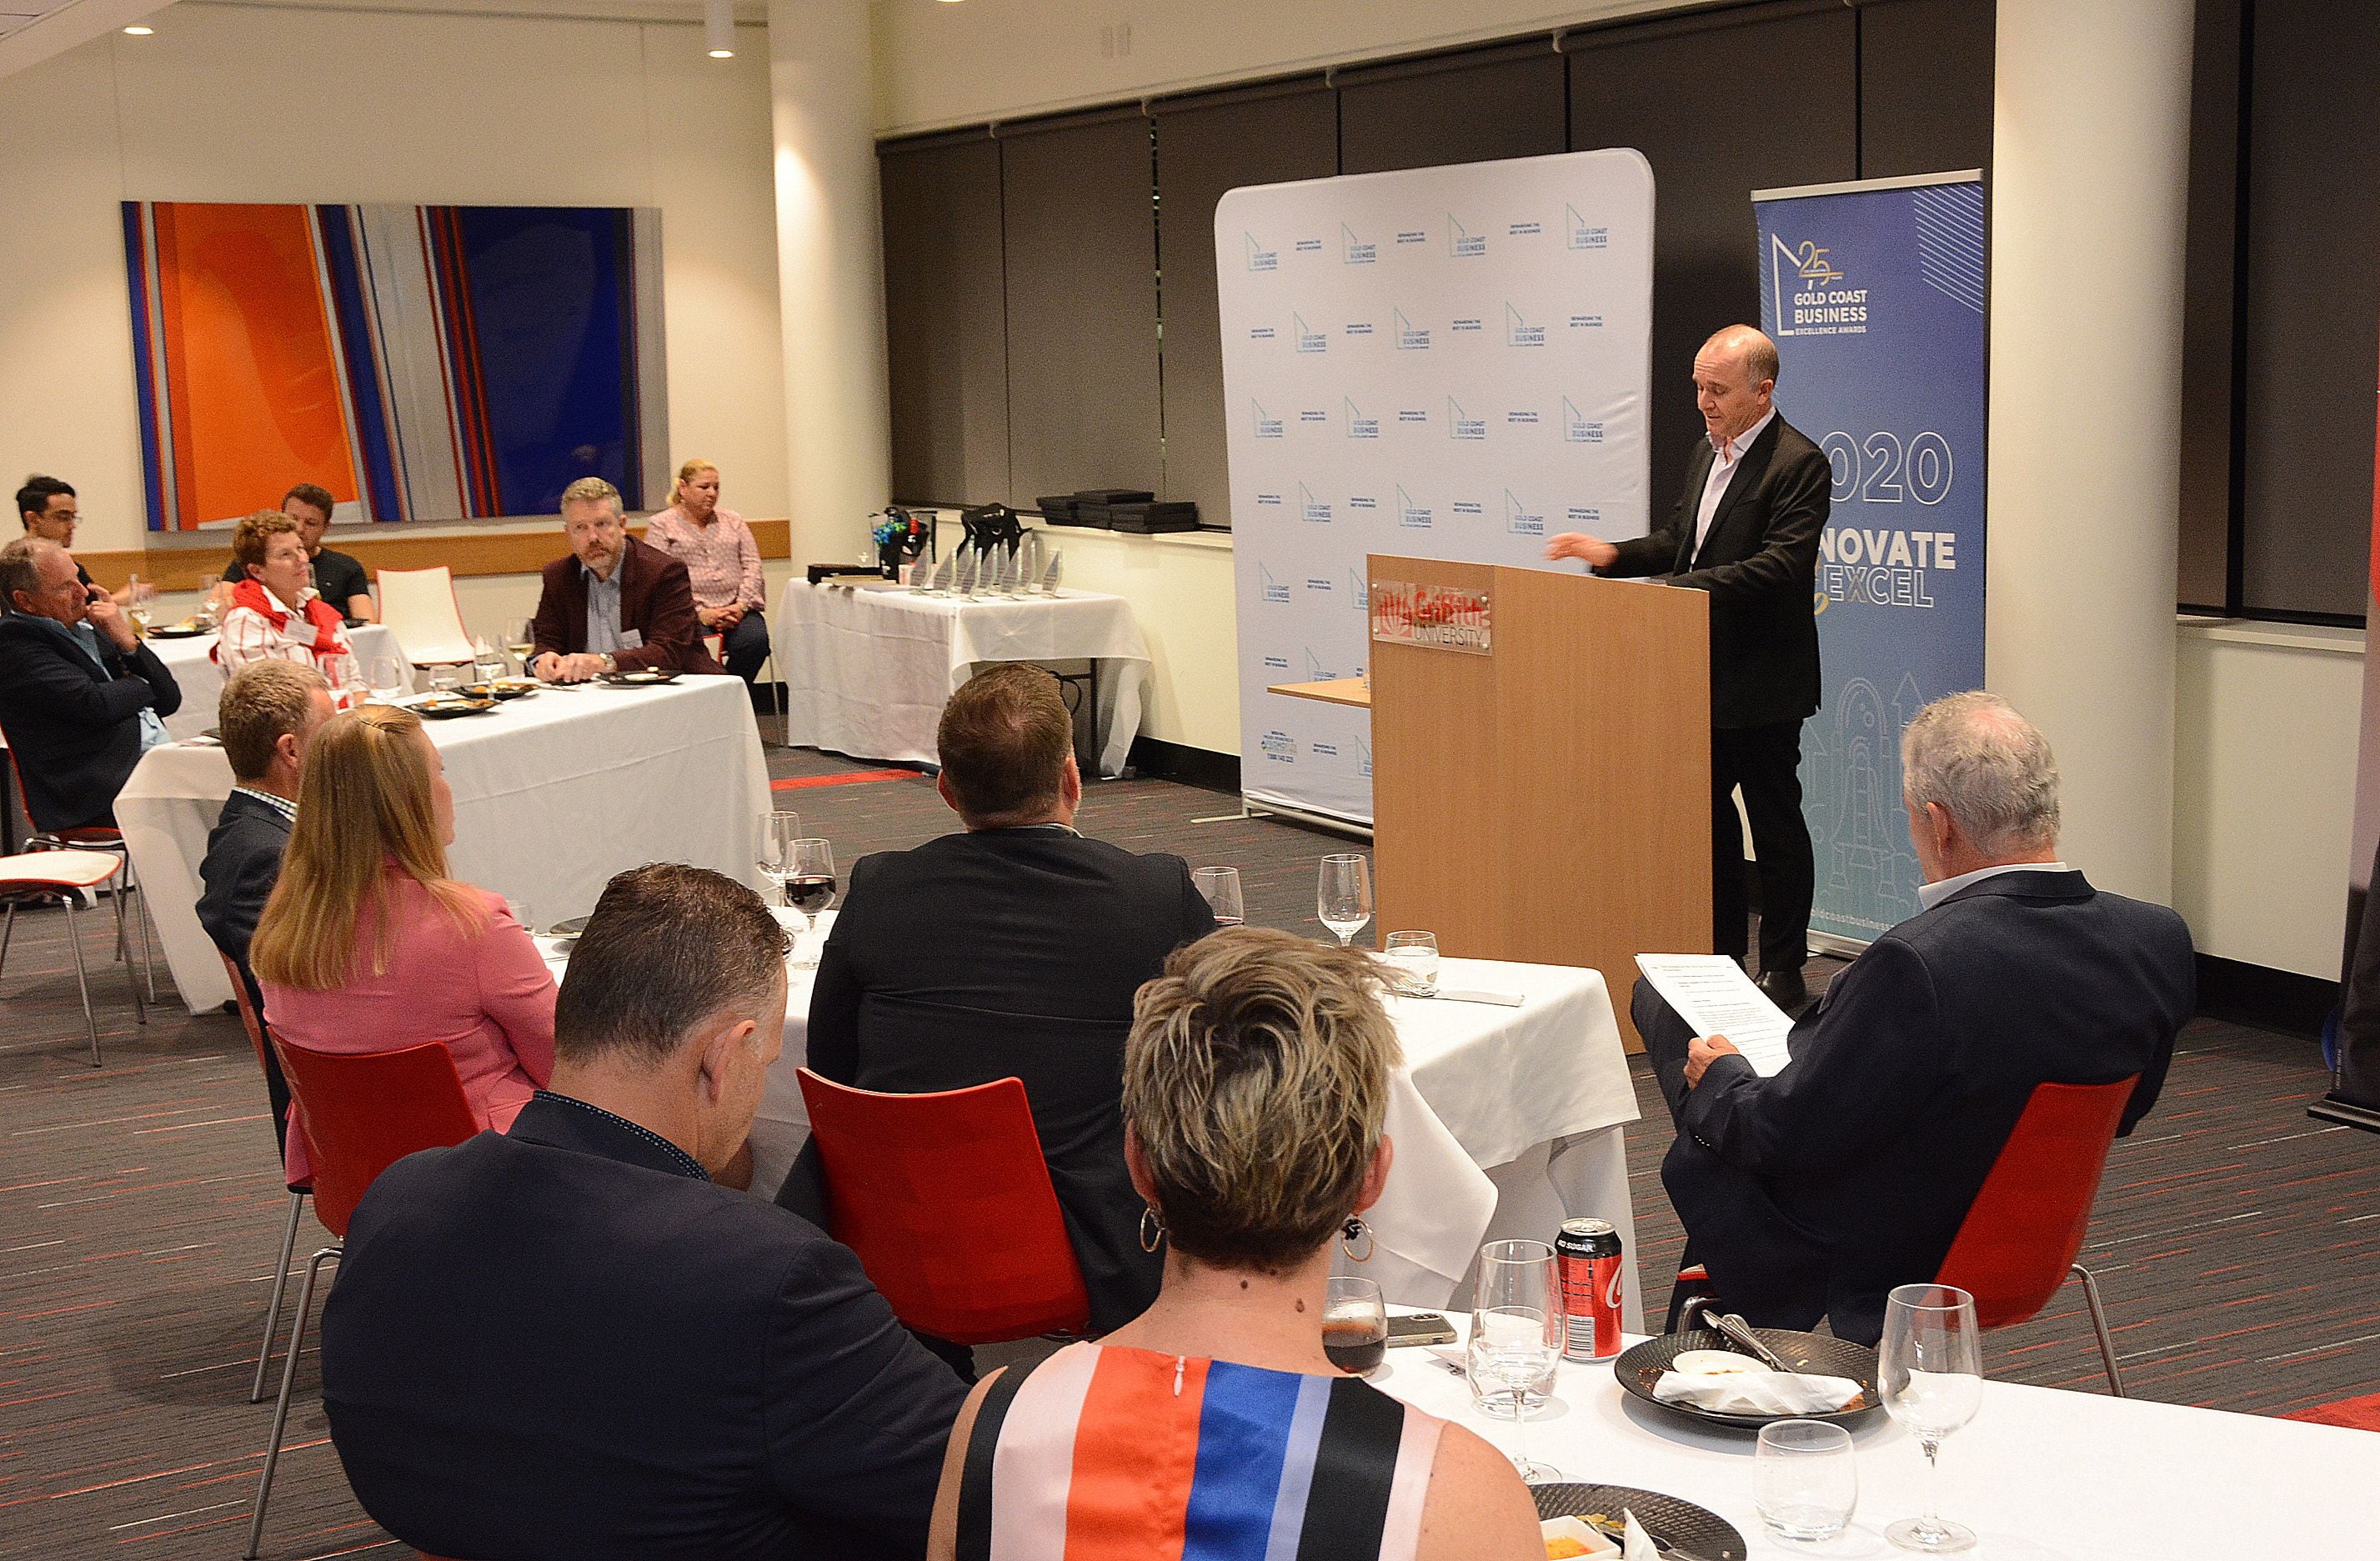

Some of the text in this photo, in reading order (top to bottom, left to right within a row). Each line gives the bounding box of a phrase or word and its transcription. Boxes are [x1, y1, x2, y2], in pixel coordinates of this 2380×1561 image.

[1576, 235, 1607, 244] BUSINESS
[1457, 243, 1486, 253] BUSINESS
[1799, 241, 1843, 285] 25
[1794, 289, 1868, 306] GOLD COAST
[1794, 306, 1868, 324] BUSINESS
[1795, 325, 1867, 336] EXCELLENCE AWARDS
[1516, 334, 1545, 343] BUSINESS
[1819, 431, 1953, 505] 020
[1405, 515, 1431, 523] BUSINESS
[1515, 522, 1544, 531] BUSINESS
[1818, 528, 1957, 569] NOVATE
[1824, 564, 1934, 608] EXCEL
[1414, 623, 1483, 648] UNIVERSITY
[1566, 1242, 1595, 1253] SUGAR
